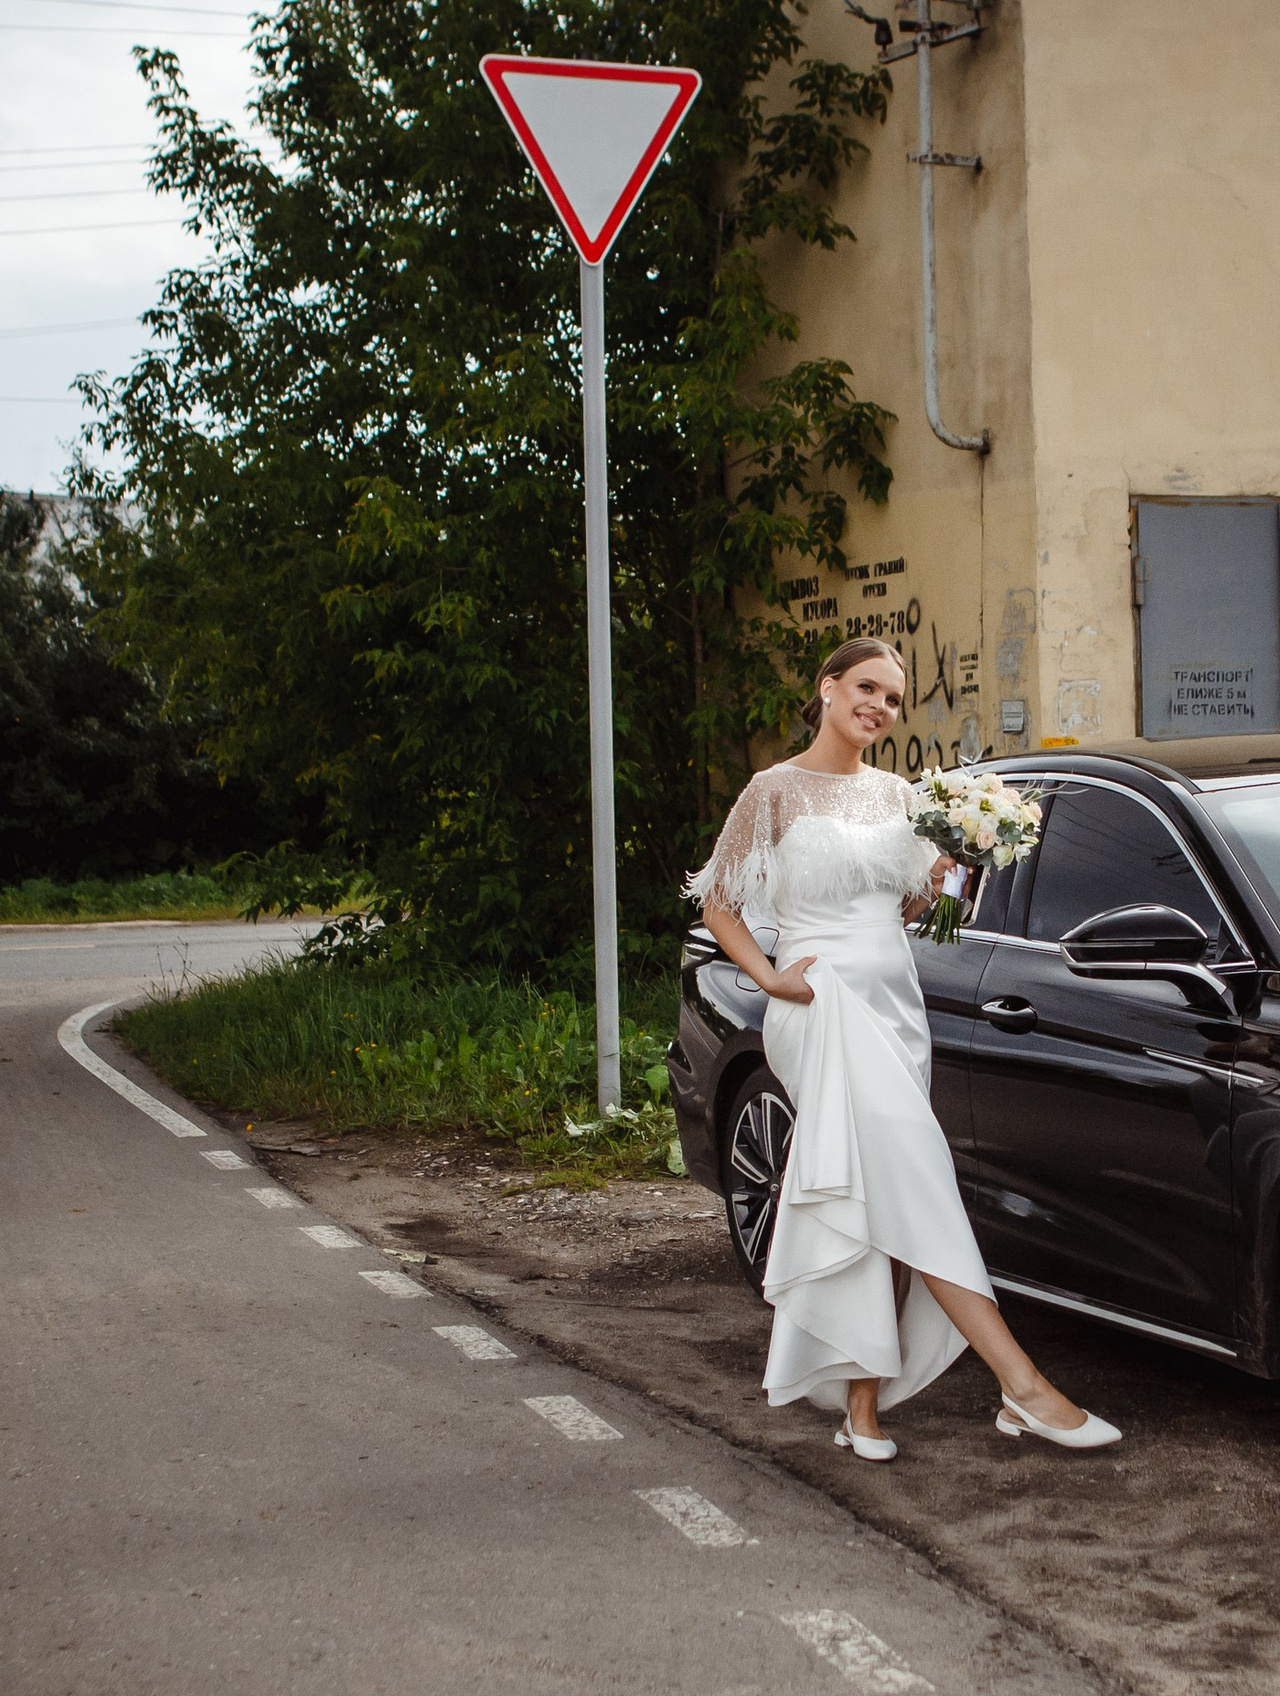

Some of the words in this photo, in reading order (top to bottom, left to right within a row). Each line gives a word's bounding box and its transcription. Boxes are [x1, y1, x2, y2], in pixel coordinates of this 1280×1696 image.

[874, 557, 904, 577] ГРАВИЙ
[786, 575, 819, 600] ЫВОЗ
[802, 597, 838, 622] МУСОРА
[845, 610, 905, 638] 28-28-78
[1173, 670, 1250, 683] ТРАНСПОРТ
[1226, 687, 1234, 699] 5
[1173, 704, 1188, 715] НЕ
[1191, 703, 1250, 715] СТАВИТЬ
